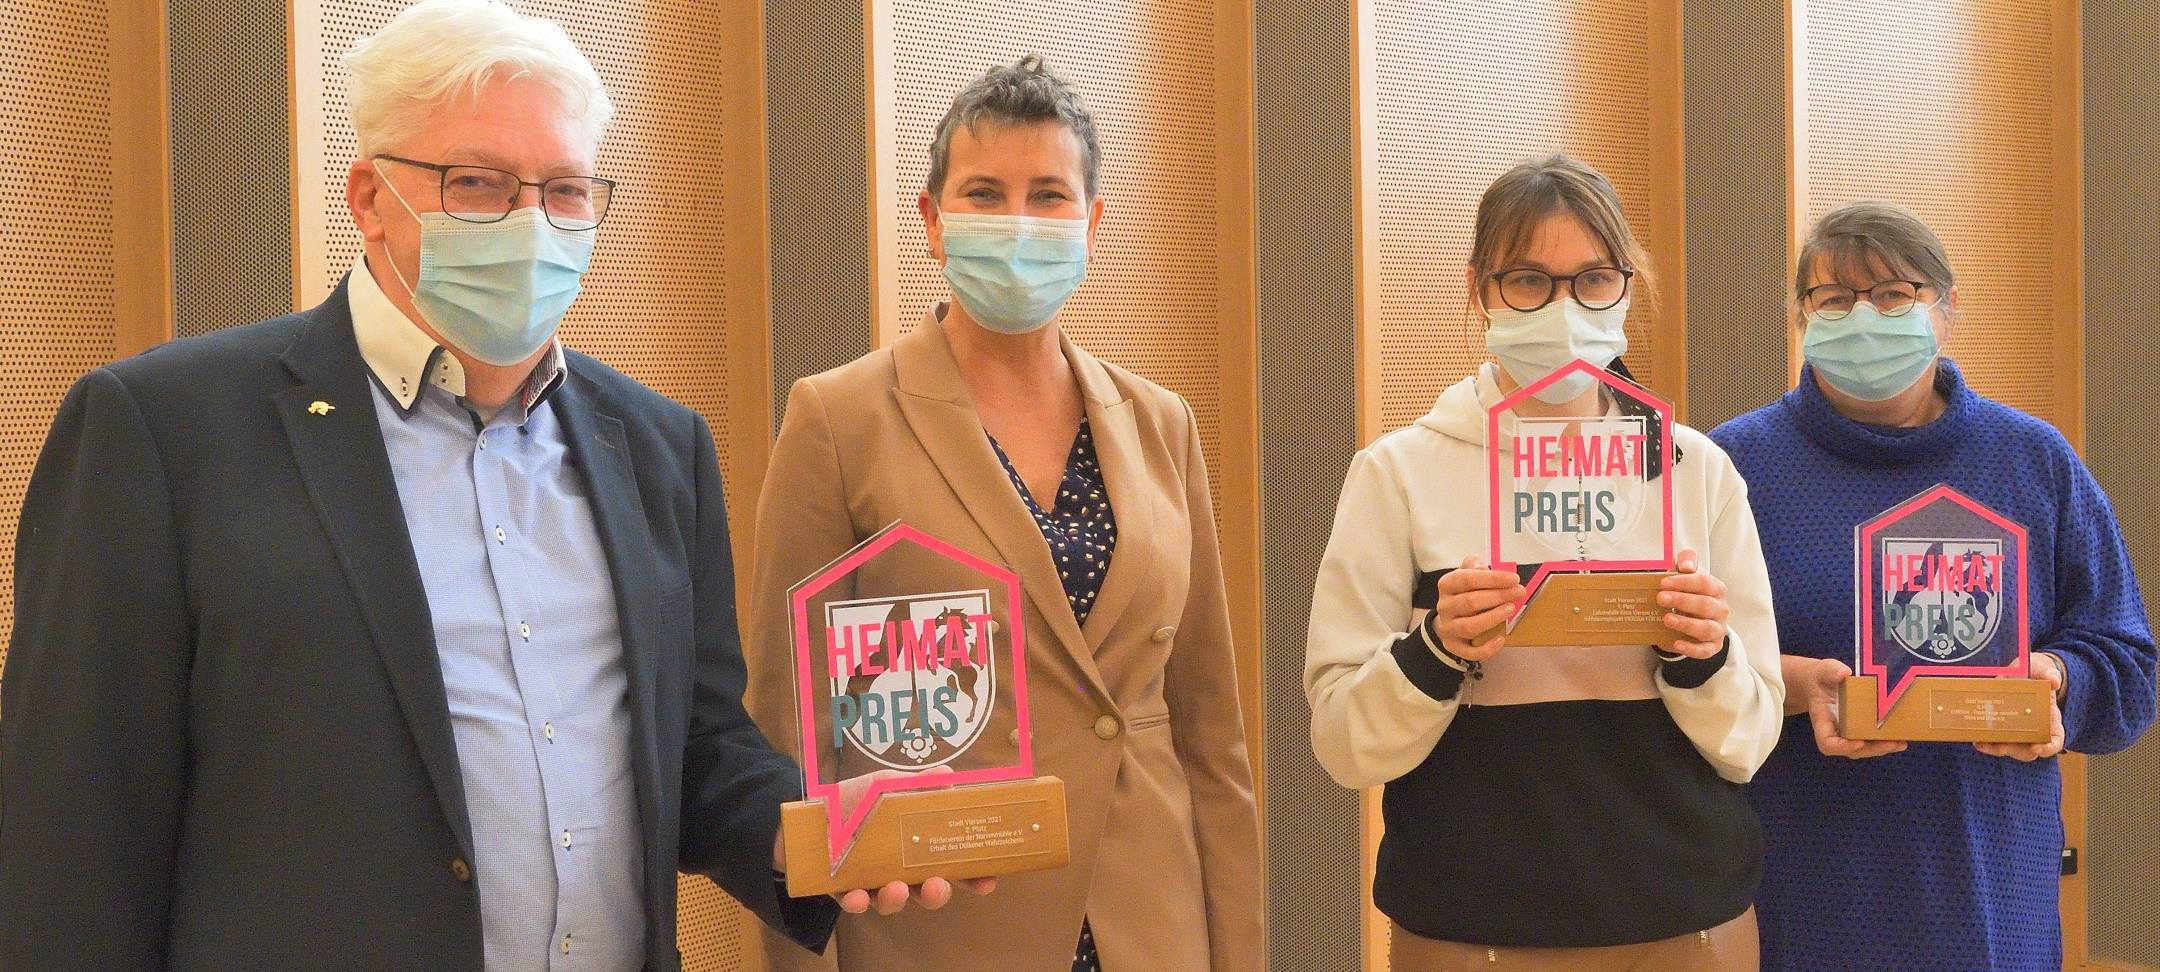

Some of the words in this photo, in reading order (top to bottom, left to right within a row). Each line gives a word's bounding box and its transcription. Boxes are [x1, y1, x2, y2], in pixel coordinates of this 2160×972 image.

[1513, 435, 1647, 478] HEIMAT
[1514, 490, 1615, 533] PREIS
[1883, 554, 2006, 593] HEIMAT
[1884, 603, 1976, 641] PREIS
[825, 613, 993, 679] HEIMAT
[831, 686, 959, 748] PREIS
[929, 835, 964, 845] Förderverein
[965, 833, 975, 841] der
[987, 815, 1002, 824] 2021
[929, 844, 947, 853] Erhalt
[947, 843, 959, 851] des
